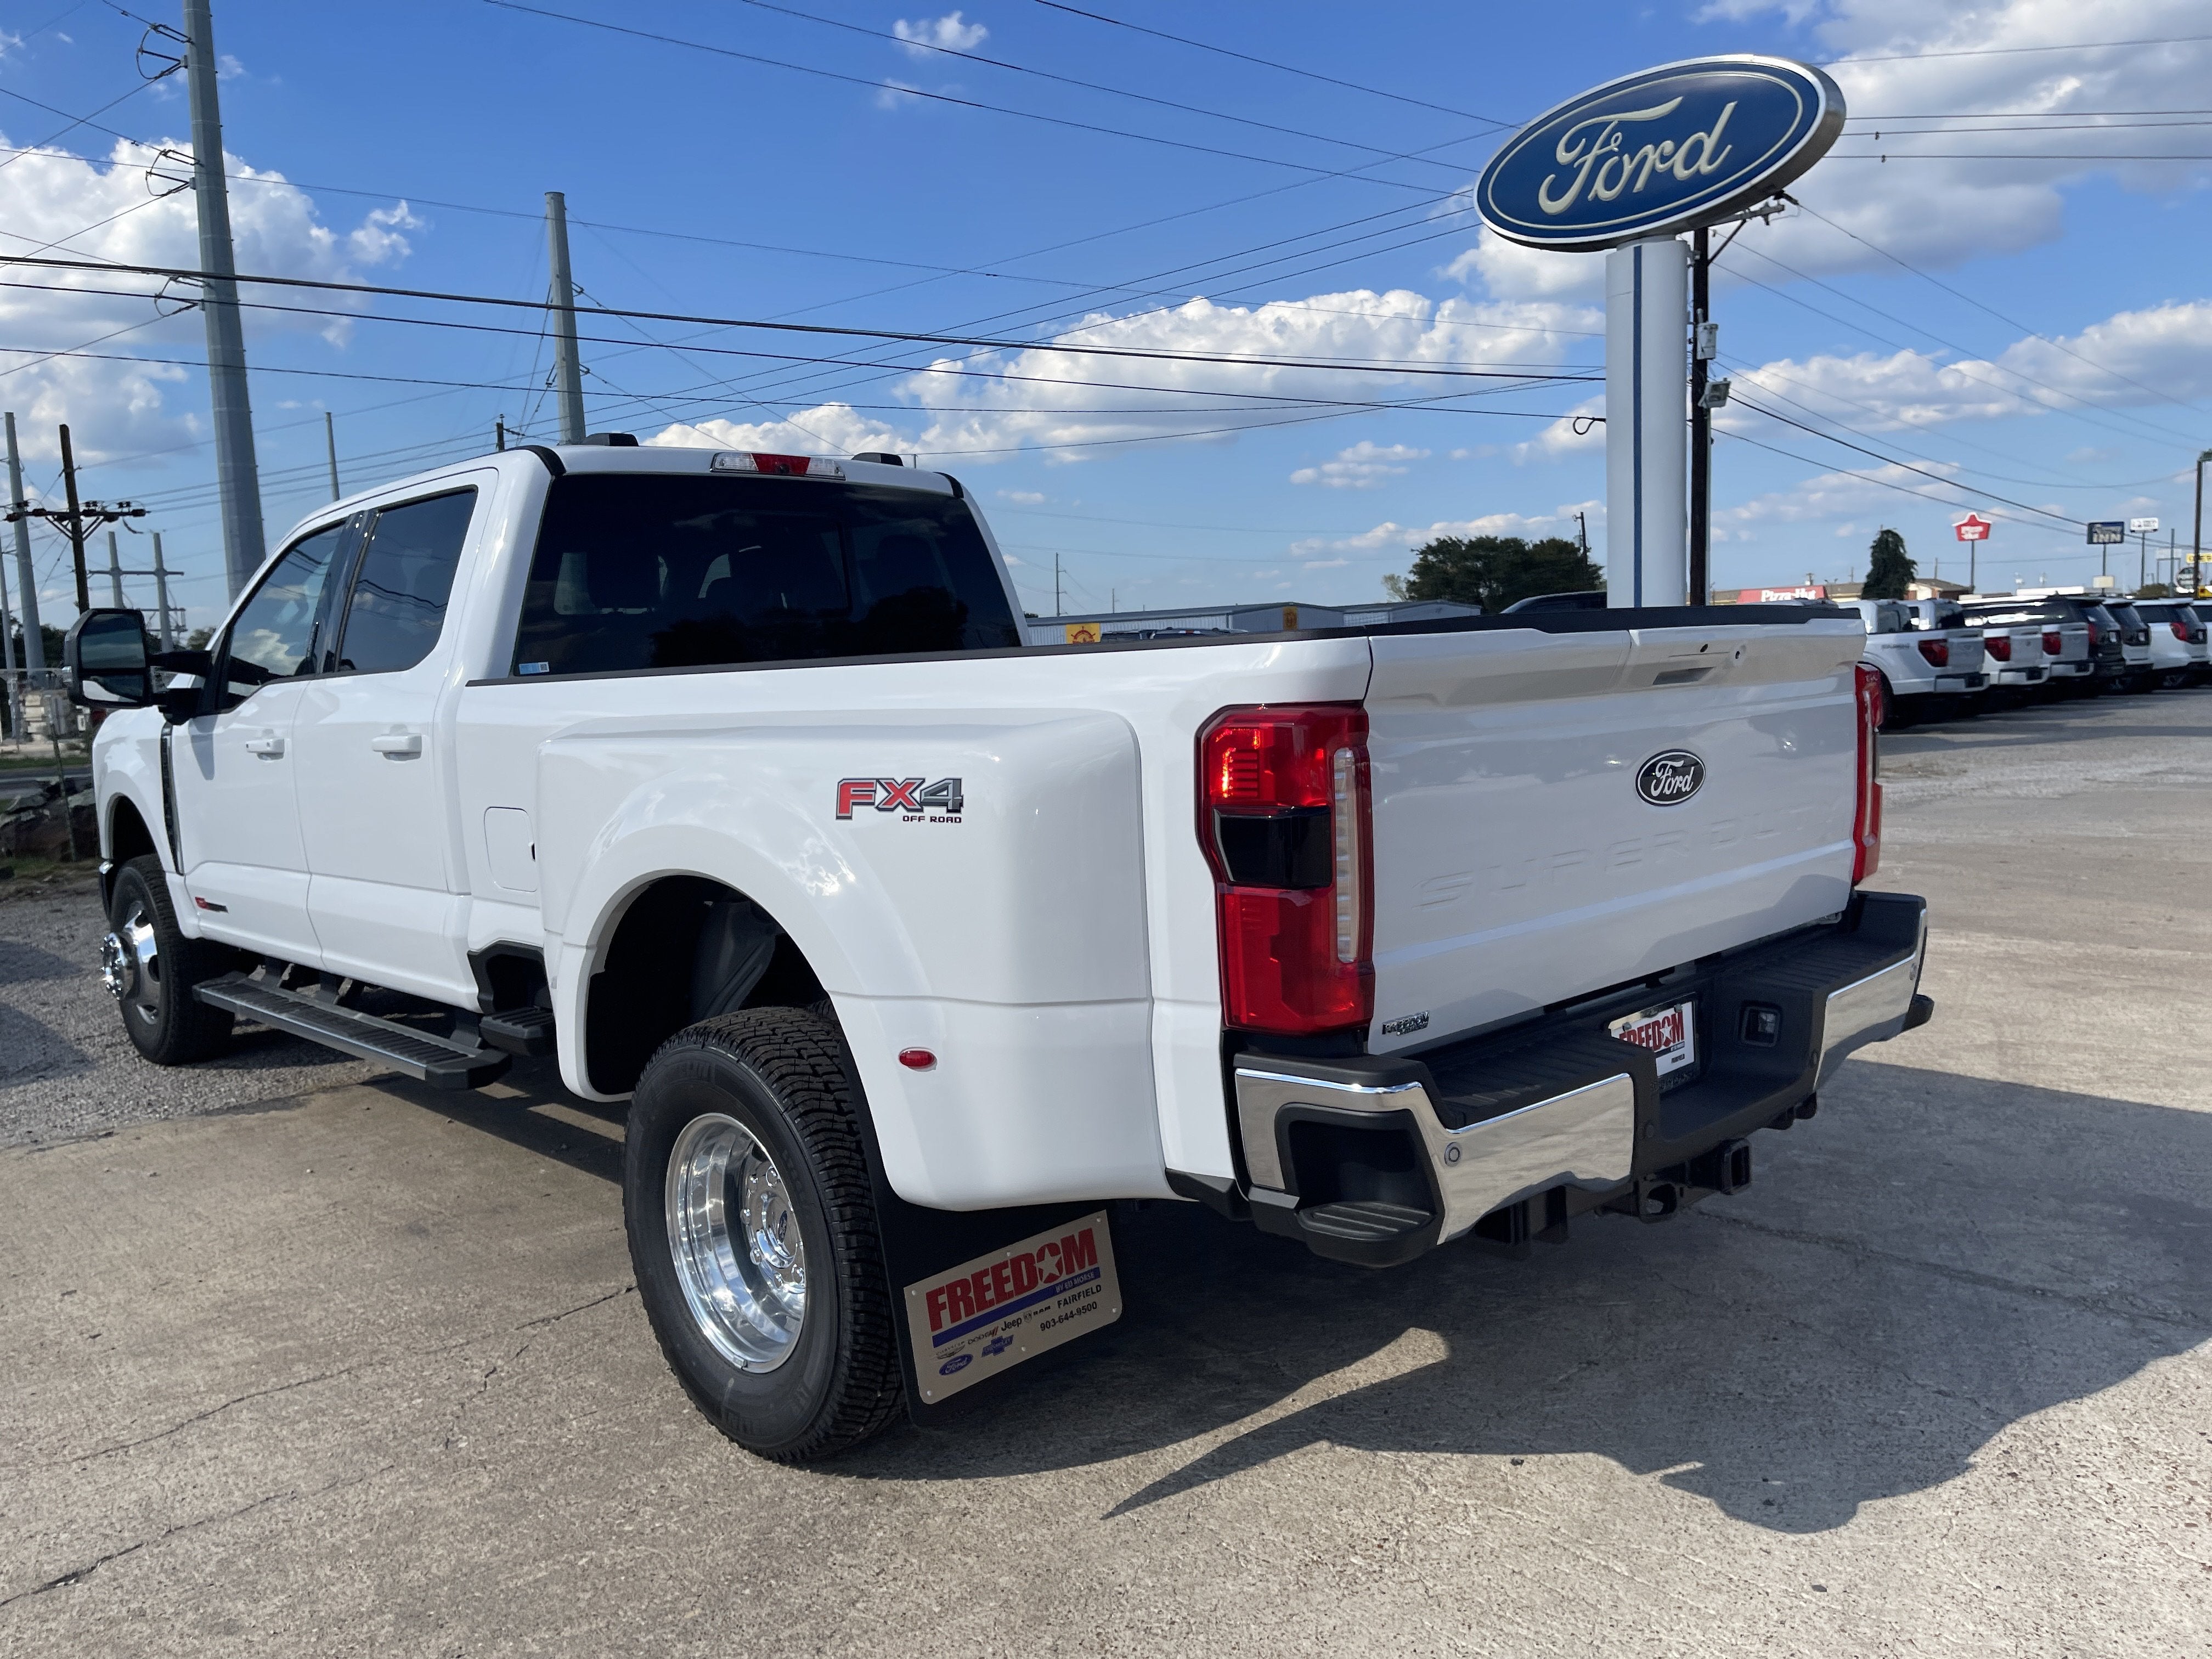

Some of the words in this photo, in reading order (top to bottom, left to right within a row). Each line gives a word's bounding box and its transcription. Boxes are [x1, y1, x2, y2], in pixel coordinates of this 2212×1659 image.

[1538, 96, 1738, 216] Ford
[1761, 590, 1792, 602] Pizza
[1651, 760, 1695, 797] Ford
[836, 777, 964, 820] FX4
[1412, 829, 1690, 912] SUPER
[926, 1228, 1098, 1332] FREEDOM
[1057, 1284, 1102, 1308] FAIRFIELD
[1001, 1317, 1022, 1331] Jeep
[1040, 1301, 1097, 1331] 903-644-9500
